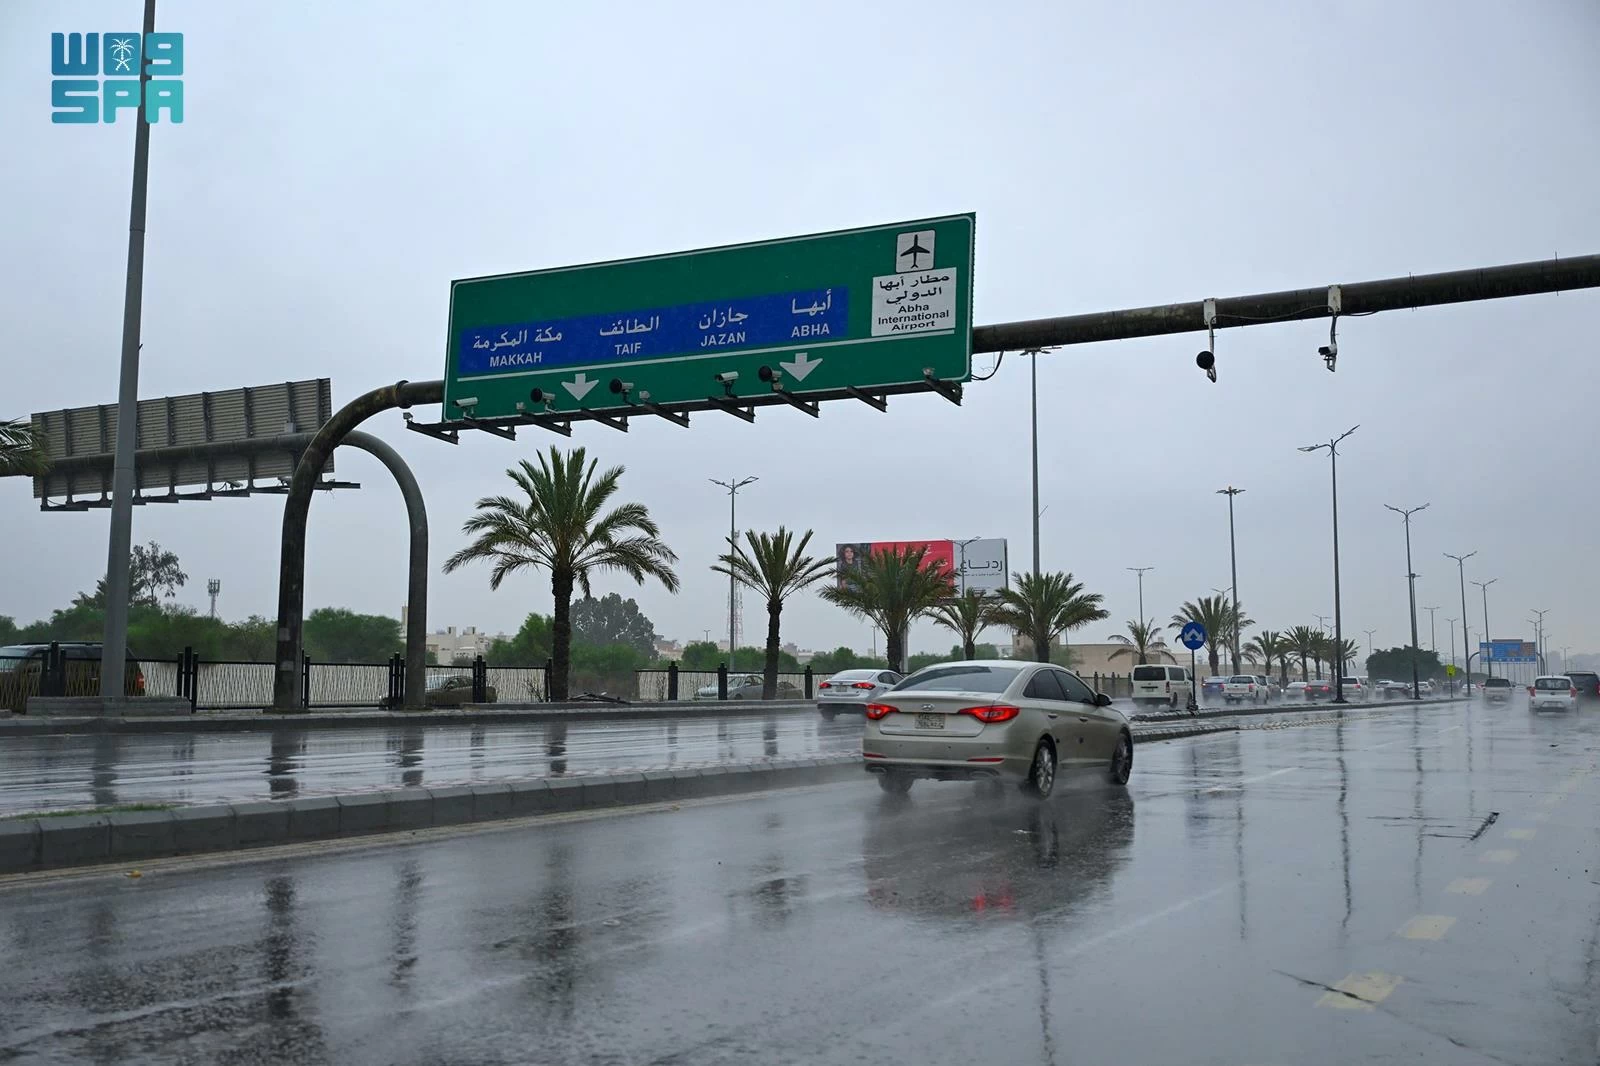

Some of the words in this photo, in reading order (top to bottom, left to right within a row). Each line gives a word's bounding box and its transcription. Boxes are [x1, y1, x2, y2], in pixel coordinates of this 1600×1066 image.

[910, 274, 950, 288] مطار
[791, 288, 832, 317] أبها
[886, 286, 942, 305] الدولي
[898, 303, 930, 314] Abha
[698, 306, 749, 330] جازان
[878, 309, 950, 325] International
[599, 315, 660, 337] الطائف
[791, 323, 830, 338] ABHA
[891, 320, 936, 331] Airport
[473, 329, 528, 352] المكرمة
[534, 326, 563, 343] مكة
[700, 331, 746, 347] JAZAN
[614, 342, 642, 356] TAIF
[489, 351, 542, 368] MAKKAH
